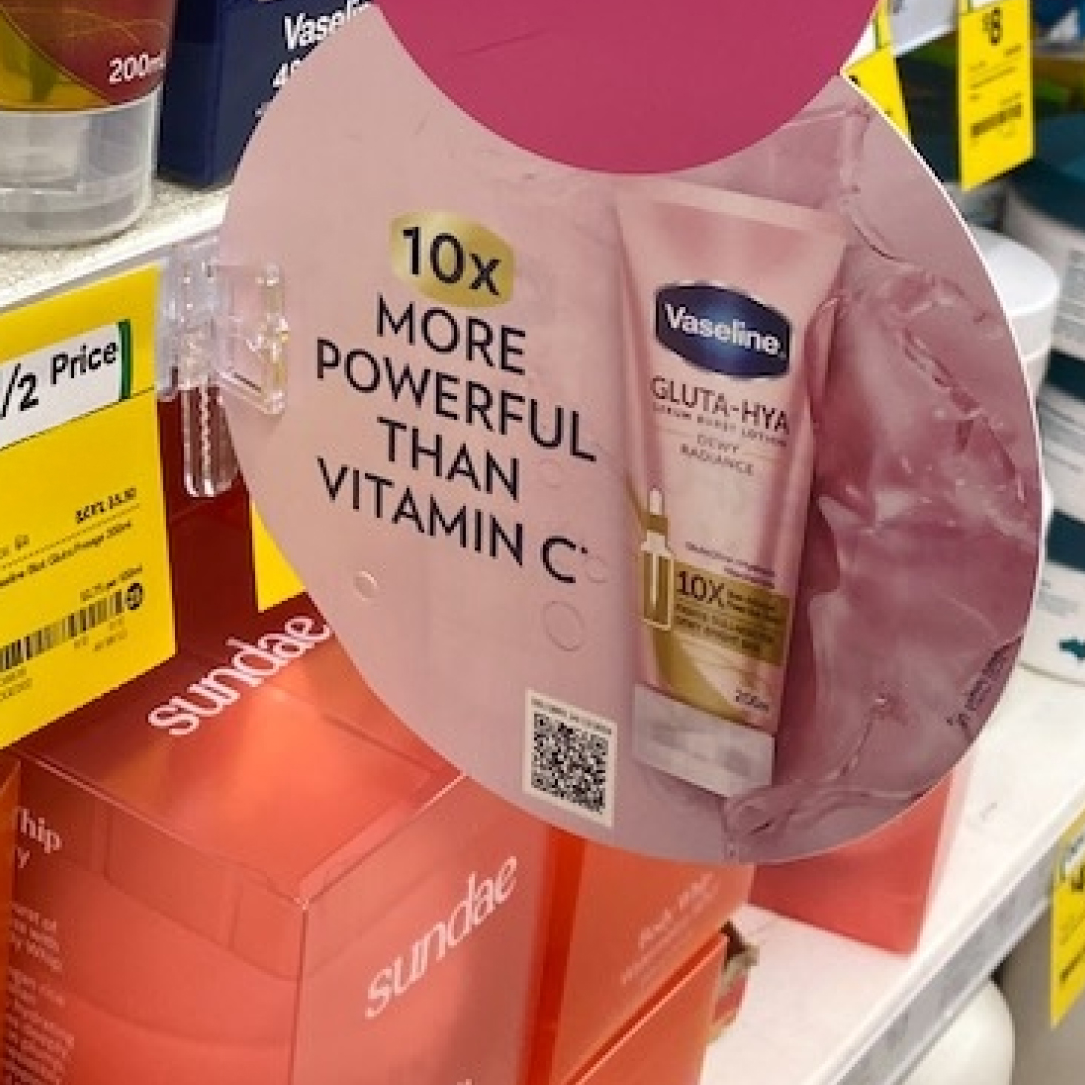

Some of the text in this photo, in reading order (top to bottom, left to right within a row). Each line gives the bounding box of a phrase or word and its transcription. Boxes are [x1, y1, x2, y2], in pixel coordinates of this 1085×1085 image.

[403, 226, 500, 296] 10x
[50, 342, 119, 386] Price
[377, 291, 526, 376] MORE
[664, 303, 782, 358] Vaseline
[317, 337, 597, 463] POWERFUL
[650, 375, 790, 435] GLUTA-HYA
[377, 416, 520, 502] THAN
[317, 455, 524, 568] VITAMIN
[676, 570, 725, 608] 10X
[147, 615, 336, 736] sundae
[364, 855, 518, 1021] sundae
